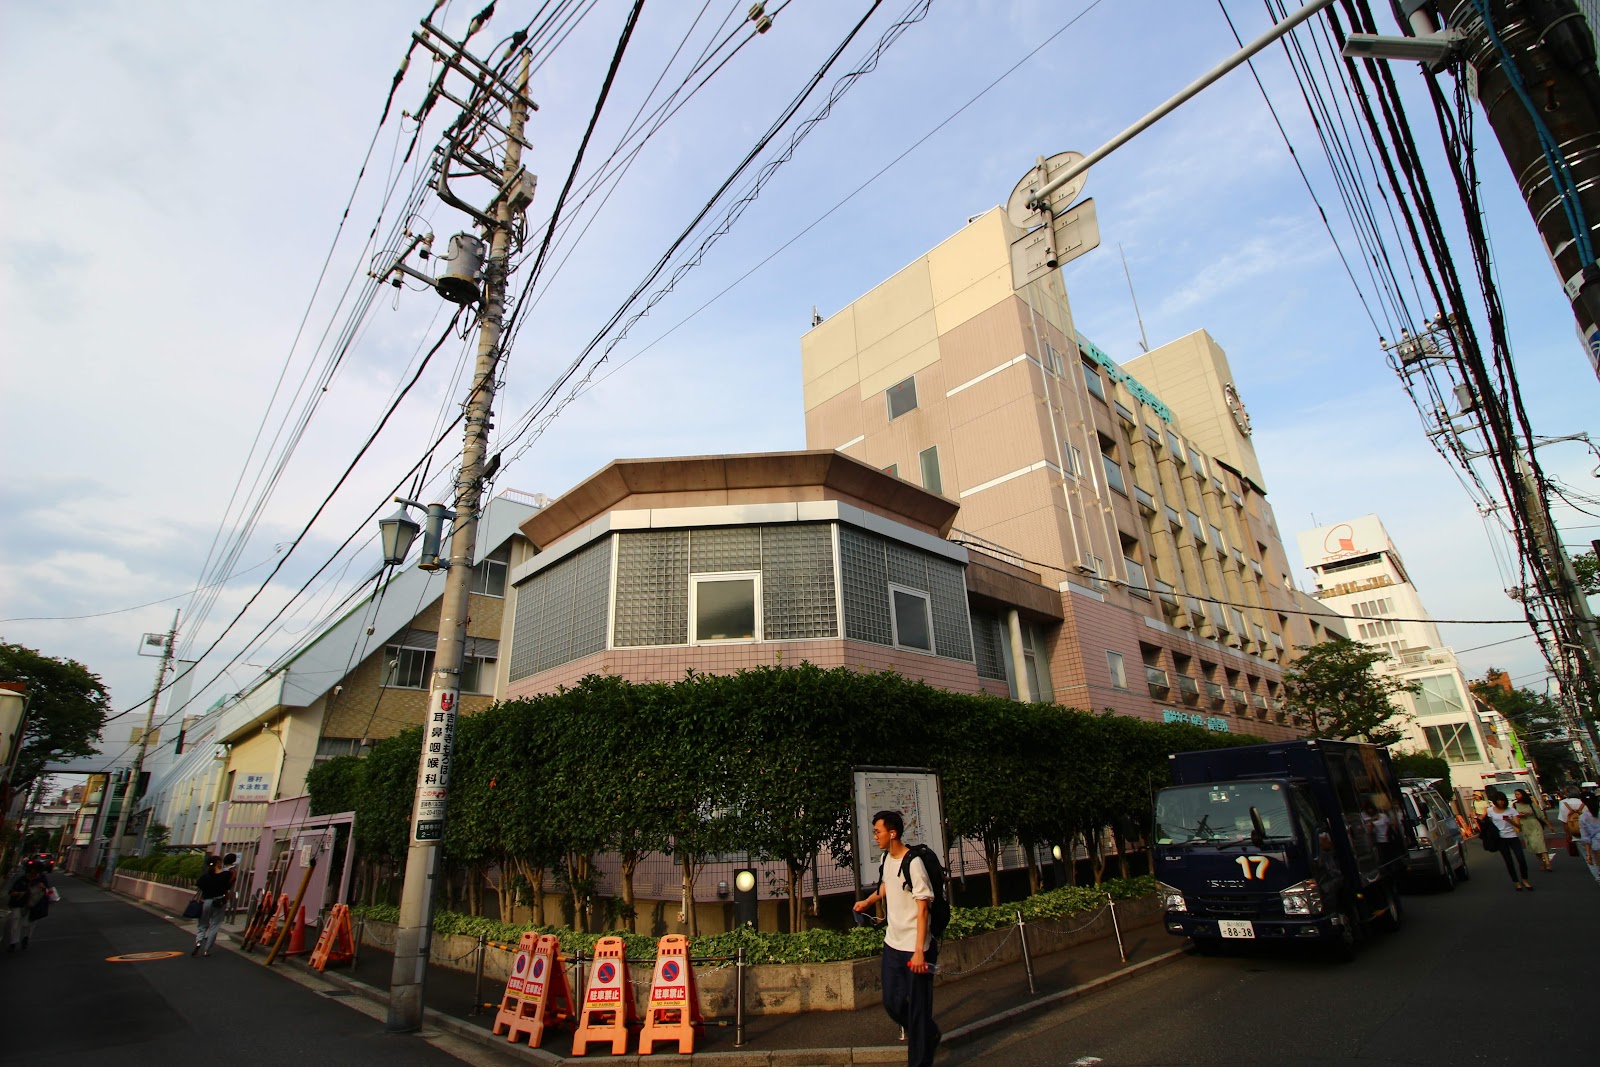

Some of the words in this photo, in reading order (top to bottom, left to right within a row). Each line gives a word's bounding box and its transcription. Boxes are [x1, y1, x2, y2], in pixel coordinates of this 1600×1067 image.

[1322, 548, 1368, 562] TOKYU
[425, 713, 445, 785] 耳鼻咽喉科
[238, 783, 269, 791] 水泳教室
[1235, 855, 1270, 881] 17
[1206, 880, 1245, 888] ISUZU
[1227, 927, 1253, 937] 88-38
[589, 990, 619, 1001] 駐車禁止
[654, 988, 684, 999] 駐車禁止
